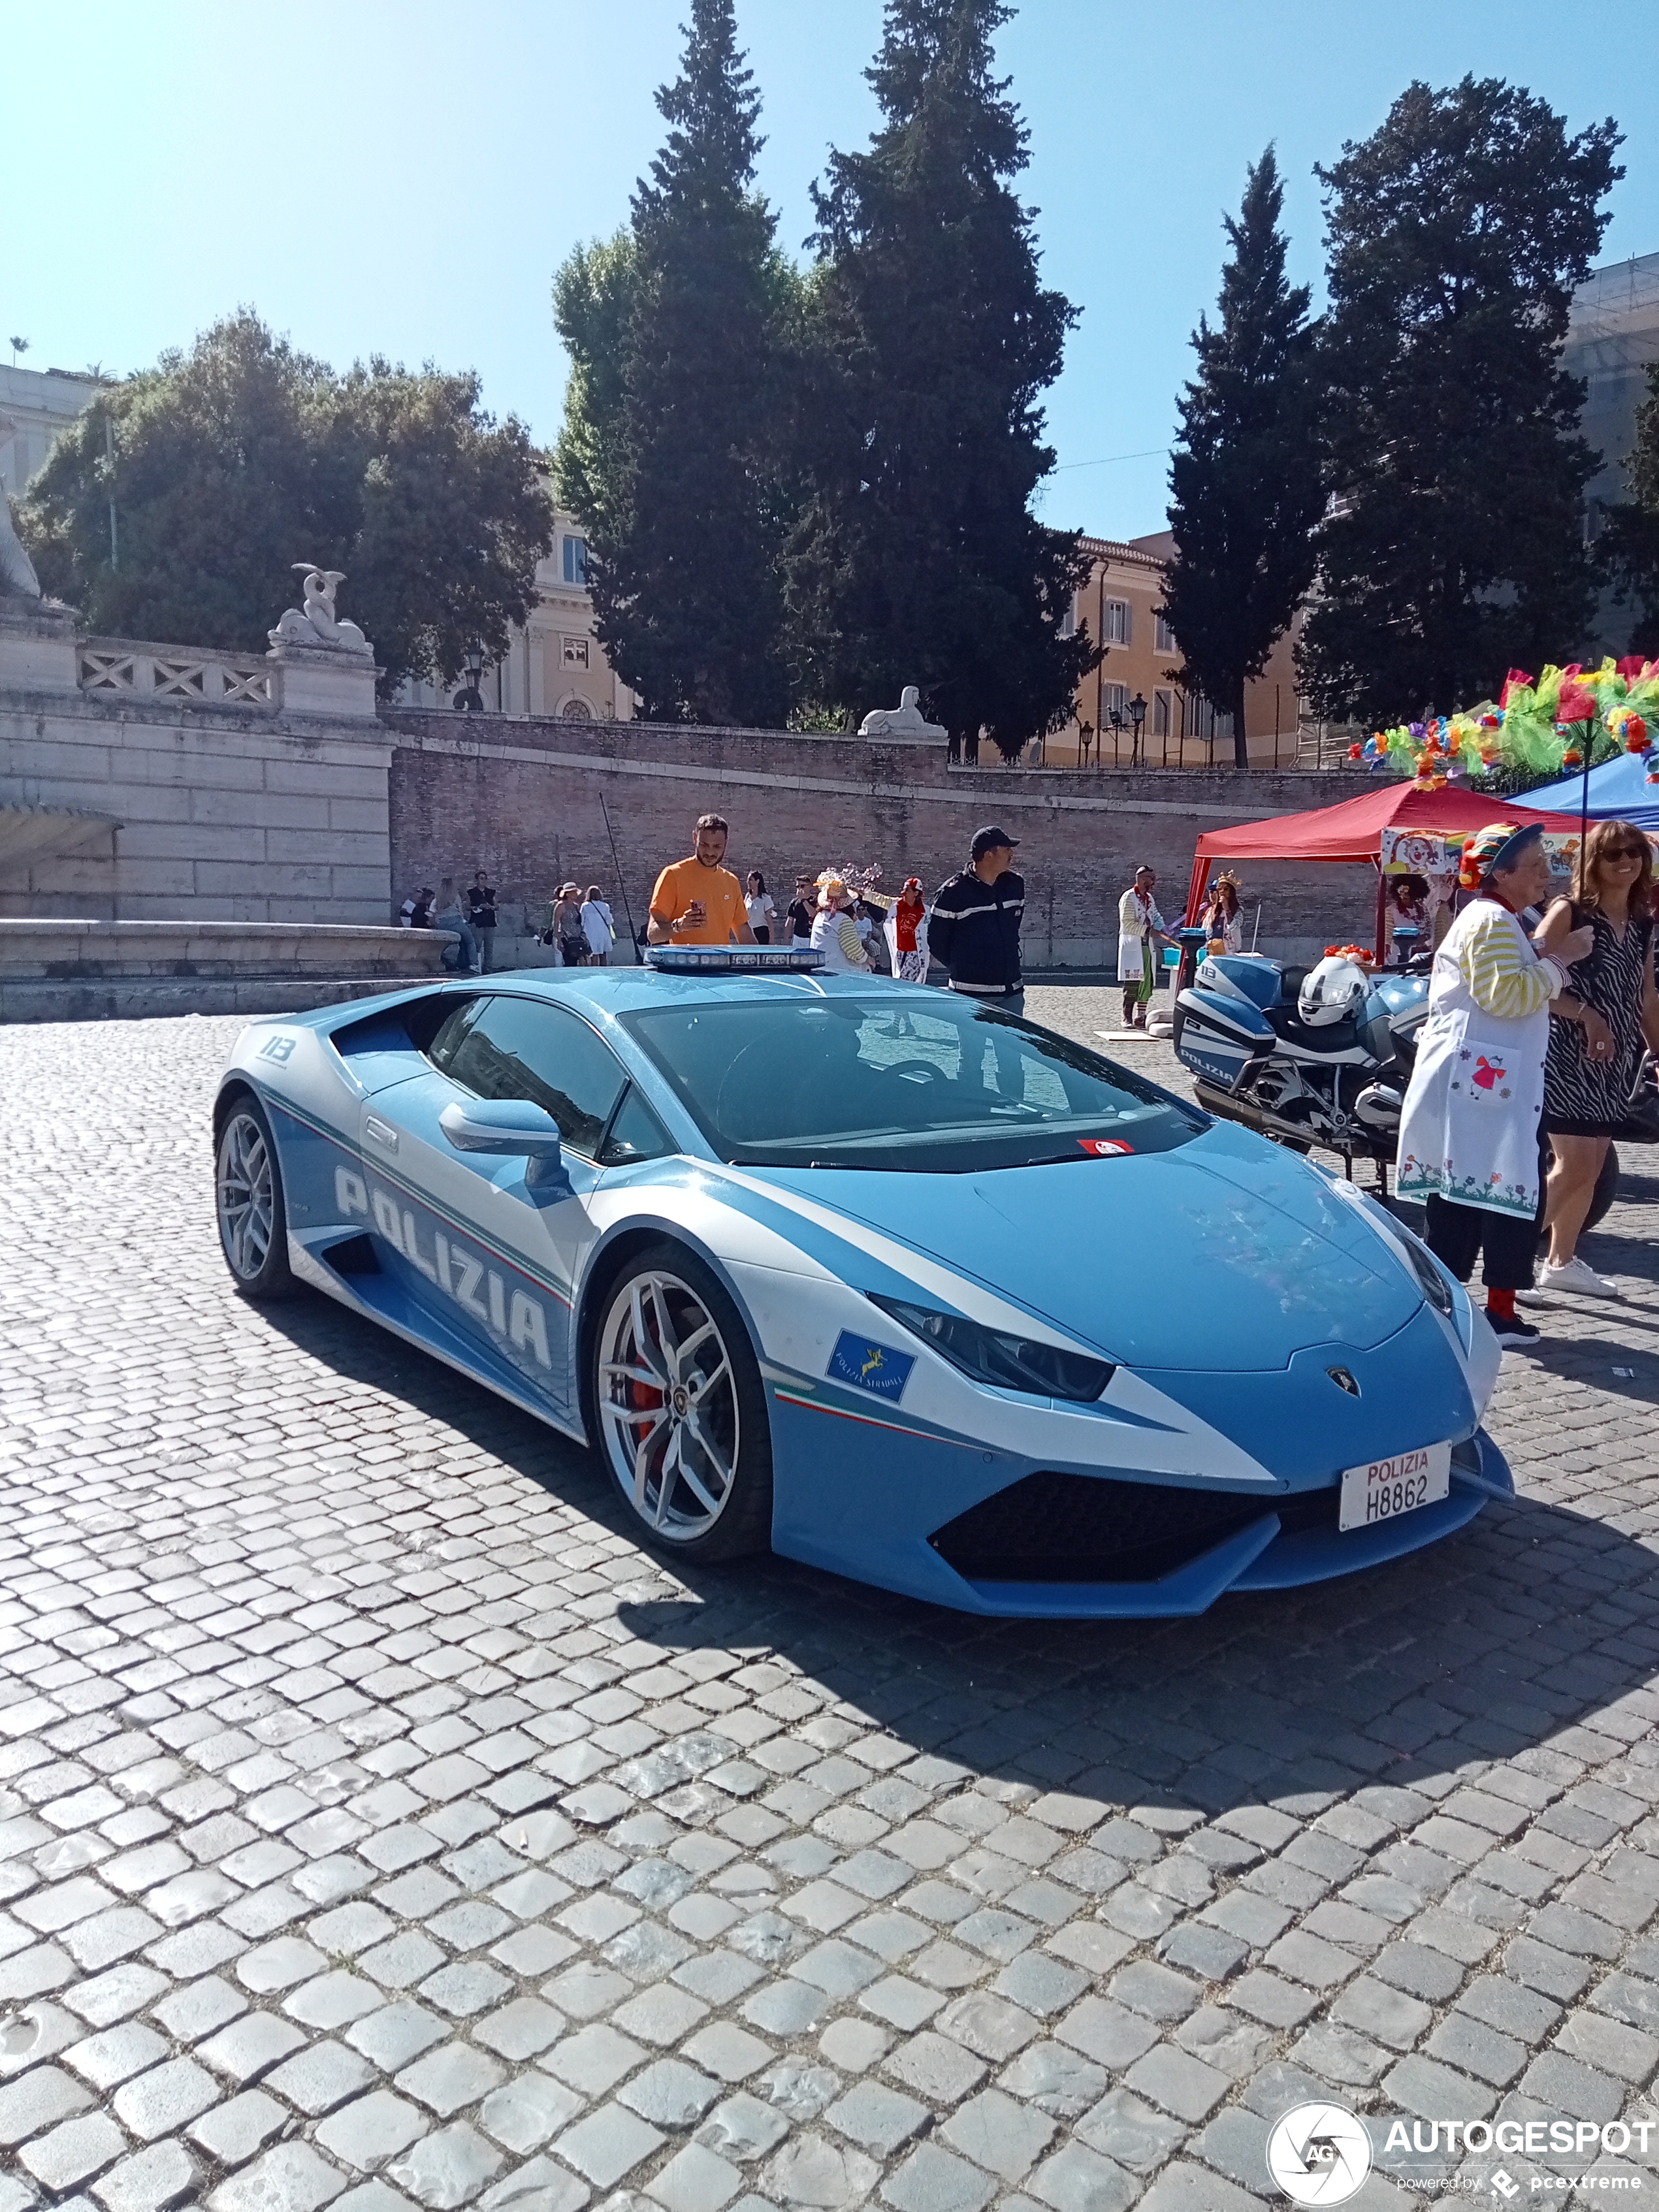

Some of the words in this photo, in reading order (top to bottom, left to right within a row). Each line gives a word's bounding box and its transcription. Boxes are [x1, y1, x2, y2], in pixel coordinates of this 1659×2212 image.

[1201, 965, 1216, 979] 113
[259, 1036, 297, 1061] 113
[1181, 1048, 1234, 1083] POLIZIA
[334, 1164, 553, 1371] POLIZIA
[835, 1352, 863, 1384] POLIZIA
[866, 1376, 903, 1388] STRADALE
[1367, 1450, 1429, 1486] POLIZIA
[1366, 1475, 1428, 1522] H8862
